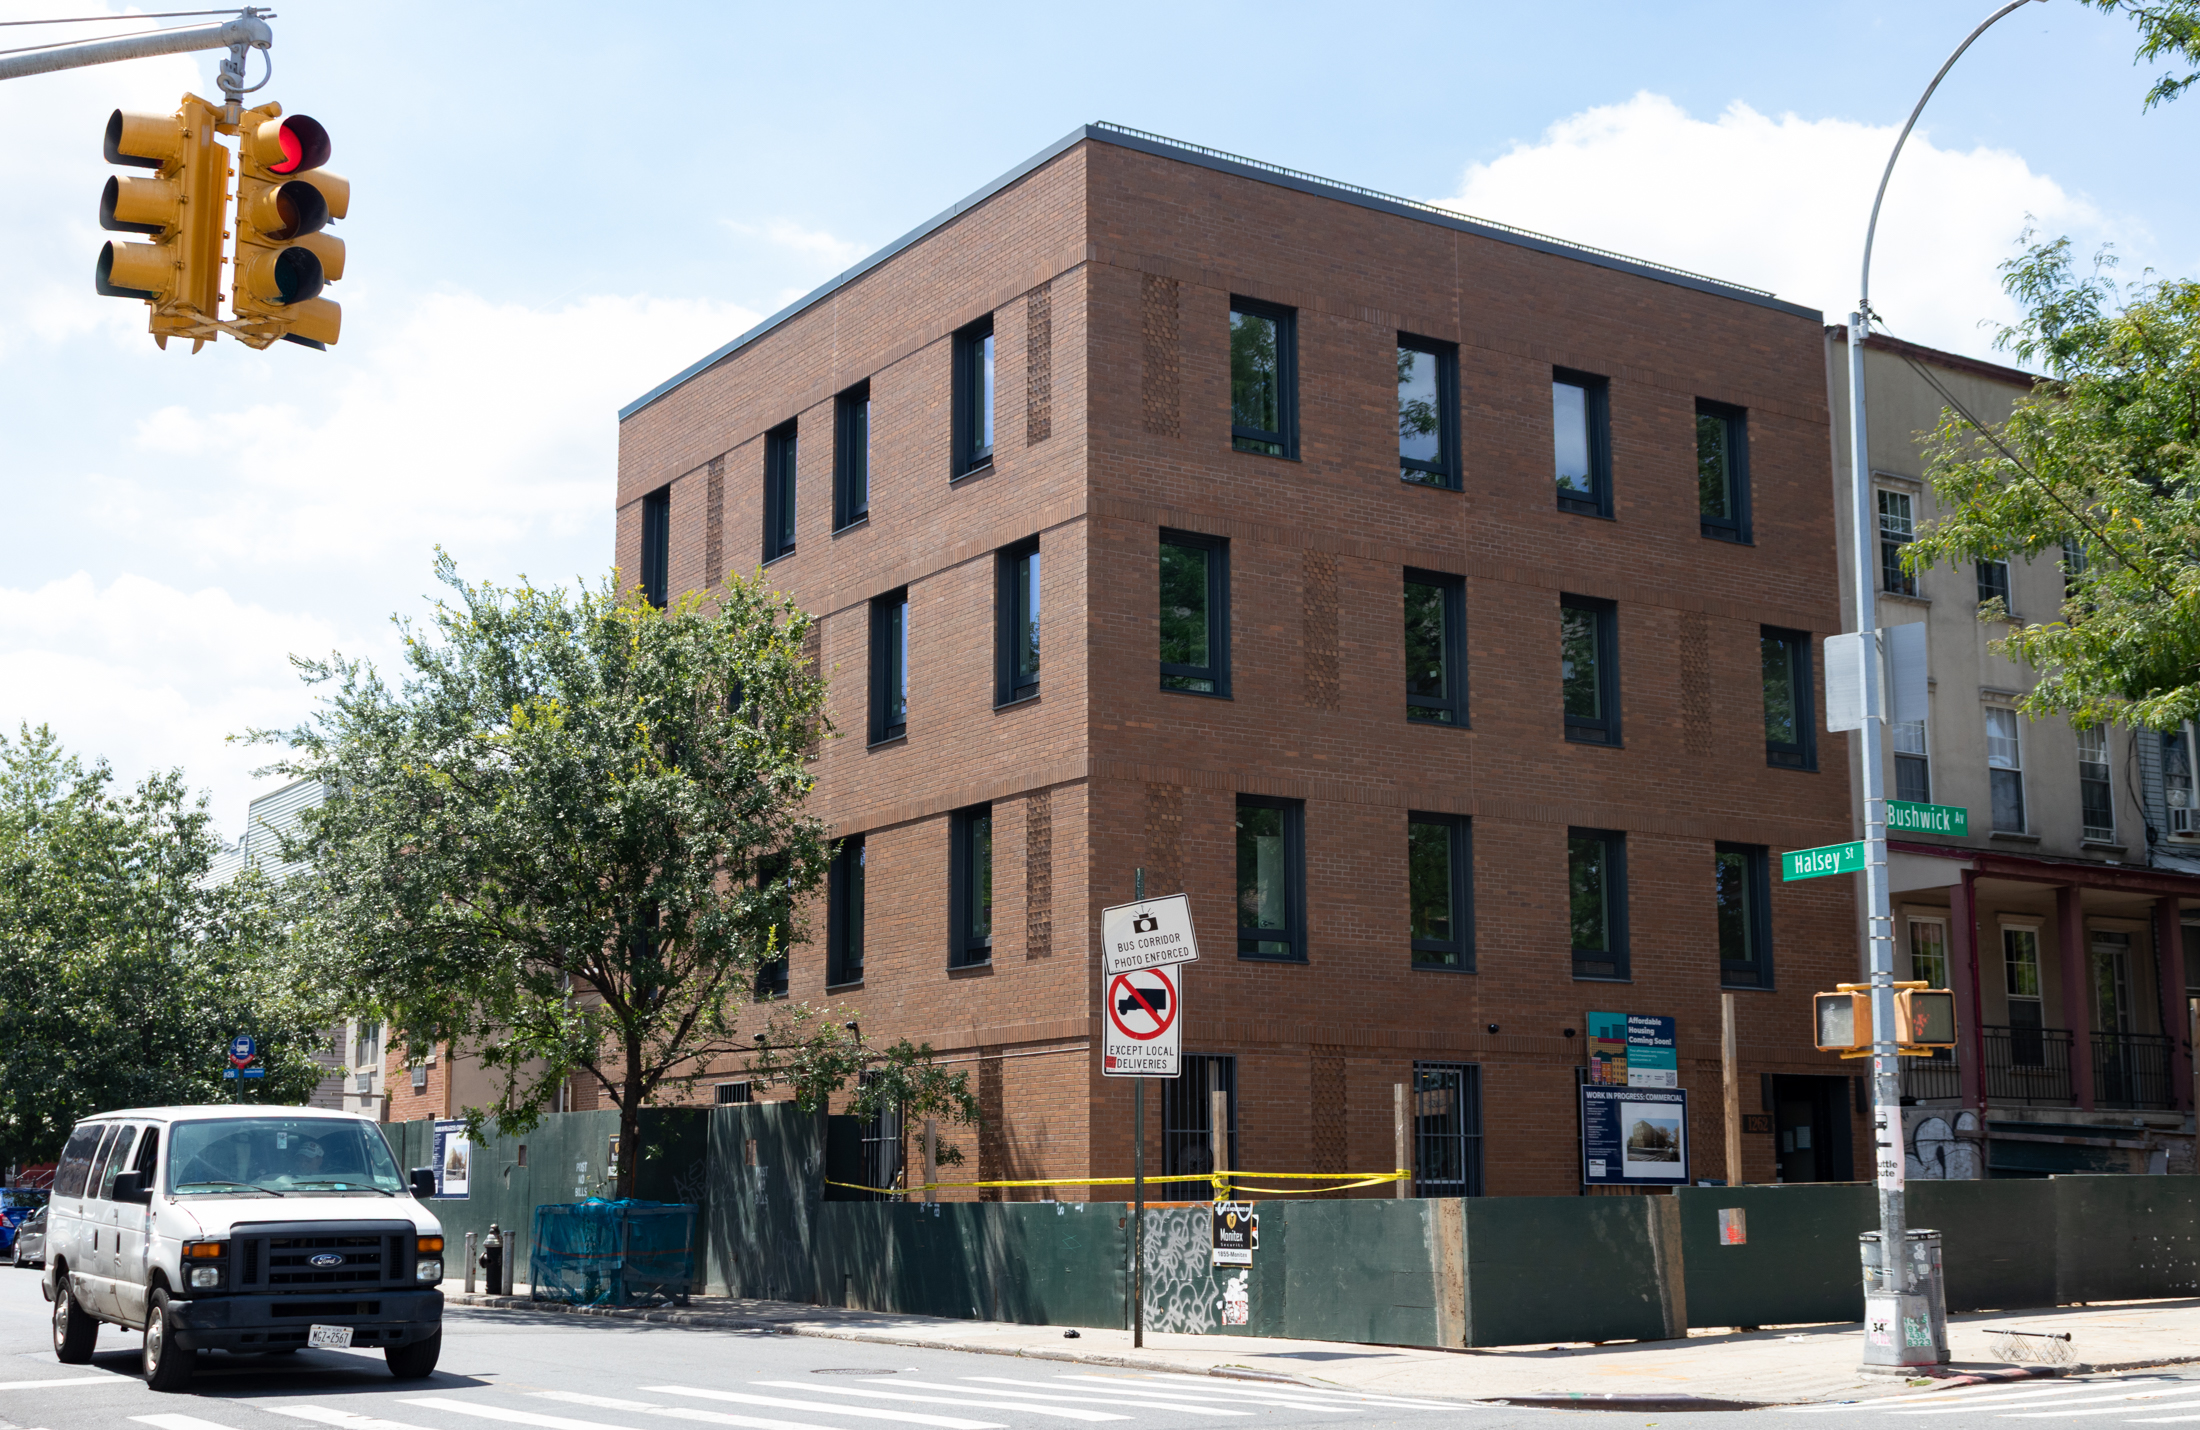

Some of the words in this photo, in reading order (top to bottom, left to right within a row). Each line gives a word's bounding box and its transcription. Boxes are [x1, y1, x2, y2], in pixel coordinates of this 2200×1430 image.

[1887, 804, 1950, 830] Bushwick
[1955, 811, 1965, 825] Av
[1794, 851, 1840, 874] Halsey
[1845, 846, 1854, 859] St
[1117, 940, 1135, 953] BUS
[1138, 932, 1181, 949] CORRIDOR
[1114, 955, 1143, 969] PHOTO
[1145, 946, 1190, 963] ENFORCED
[1628, 1016, 1662, 1026] Affordable
[1628, 1026, 1655, 1036] Housing
[1628, 1036, 1653, 1045] Coming
[1109, 1045, 1143, 1055] EXCEPT
[1146, 1046, 1174, 1056] LOCAL
[1116, 1058, 1167, 1069] DELIVERIES
[1586, 1091, 1605, 1099] WORK
[1613, 1092, 1646, 1100] PROGRESS:
[1646, 1093, 1683, 1102] COMMERCIAL
[1747, 1116, 1768, 1131] 1262
[575, 1161, 588, 1172] POST
[577, 1174, 585, 1184] NO
[575, 1187, 588, 1197] BILLS
[1220, 1228, 1244, 1242] Monitex
[317, 1255, 336, 1265] Ford
[1905, 1325, 1929, 1334] (91)
[1907, 1338, 1932, 1347] 8323
